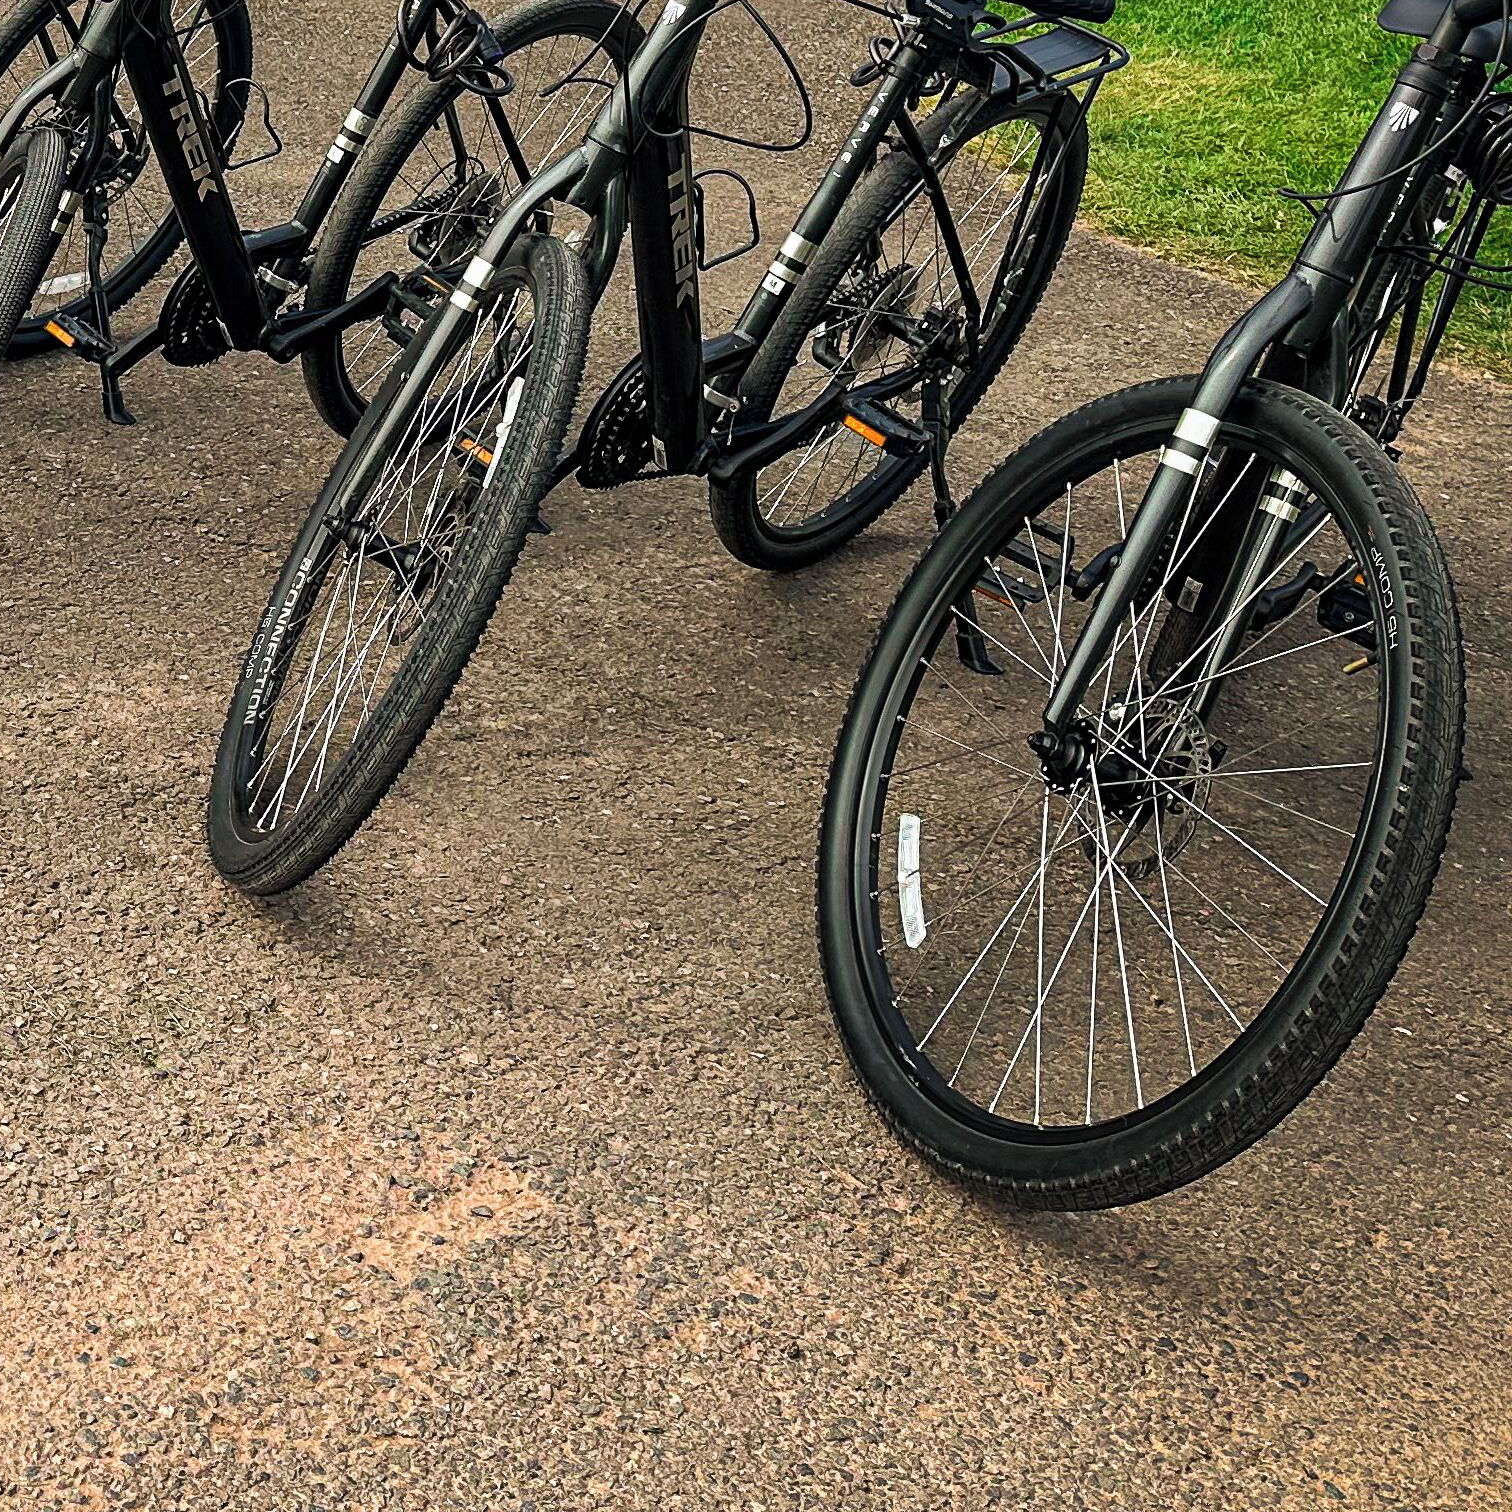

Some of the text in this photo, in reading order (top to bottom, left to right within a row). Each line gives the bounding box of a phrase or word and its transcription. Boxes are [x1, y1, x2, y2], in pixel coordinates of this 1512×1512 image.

[162, 63, 219, 204] TREK
[840, 92, 889, 164] VERVE
[667, 152, 695, 309] TREK
[1370, 547, 1394, 609] COMP
[243, 571, 306, 726] CONNECTION
[245, 633, 266, 679] COMP
